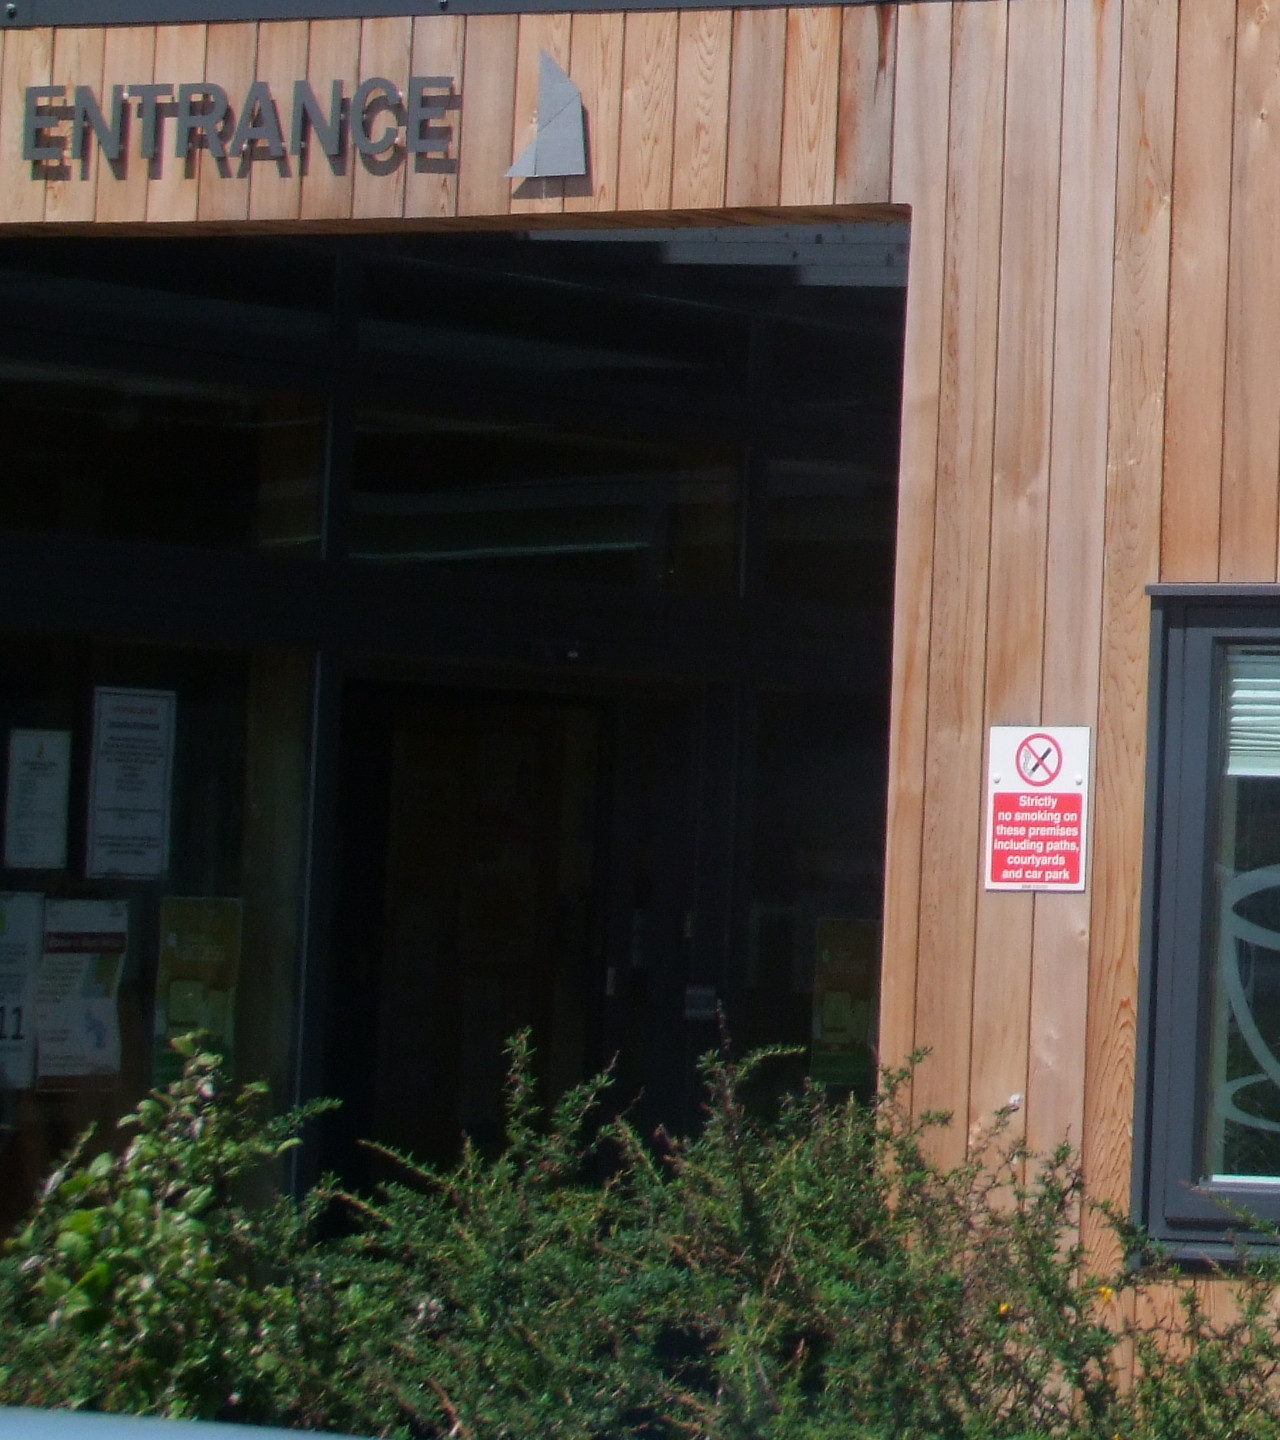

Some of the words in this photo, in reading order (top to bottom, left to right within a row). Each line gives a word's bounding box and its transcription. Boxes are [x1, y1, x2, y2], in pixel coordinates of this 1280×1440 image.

[21, 76, 456, 161] ENTRANCE
[1019, 795, 1058, 809] Strictly
[997, 811, 1012, 821] no
[1014, 810, 1061, 823] smoking
[1063, 812, 1078, 821] on
[996, 824, 1026, 836] these
[1028, 825, 1079, 838] premises
[993, 838, 1043, 853] including
[1046, 840, 1080, 853] paths,
[1007, 854, 1066, 867] courtyards
[1002, 868, 1023, 879] and
[1025, 870, 1043, 879] car
[1044, 868, 1070, 881] park
